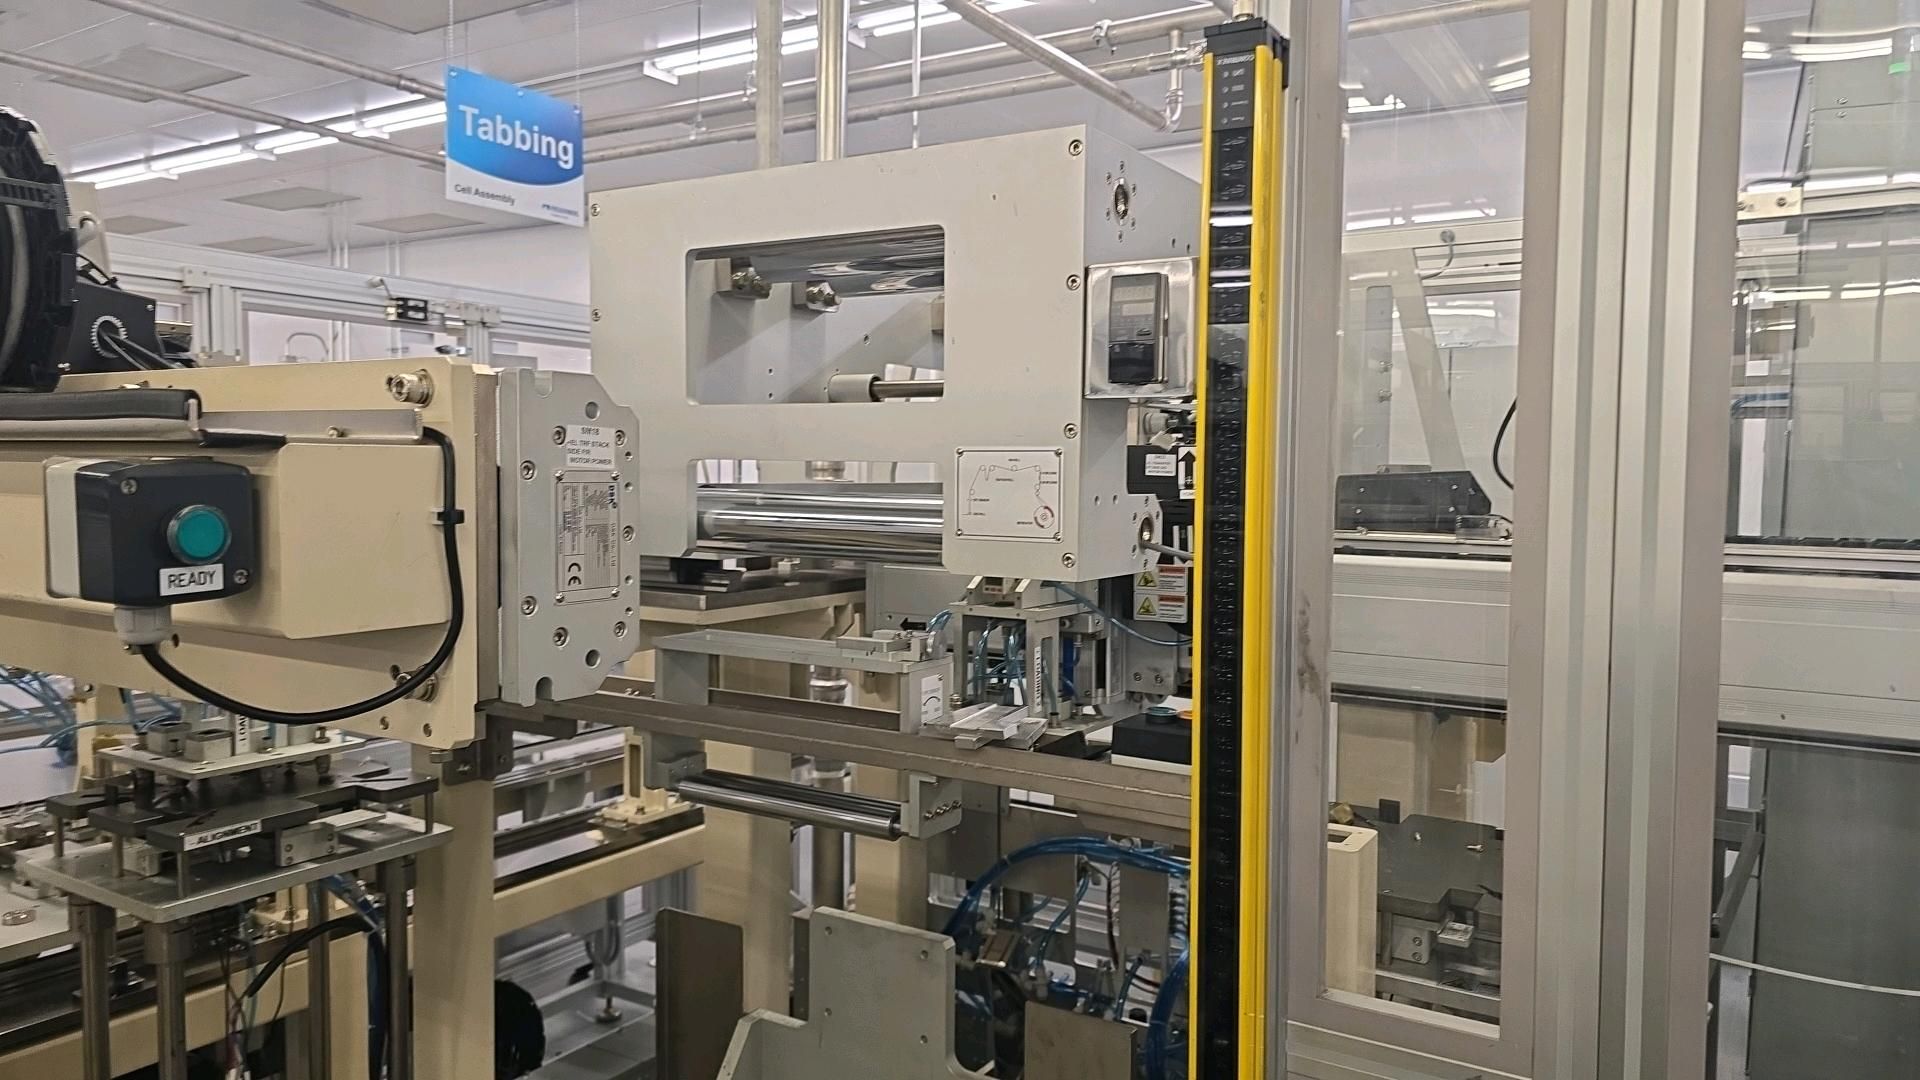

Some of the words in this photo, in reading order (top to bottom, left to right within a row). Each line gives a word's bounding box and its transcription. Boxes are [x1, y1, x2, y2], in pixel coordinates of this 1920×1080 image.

[459, 104, 574, 170] Tabbing
[454, 184, 472, 195] Cell
[474, 188, 515, 206] Assembly
[168, 570, 216, 589] READY
[197, 822, 258, 844] ALIGNMENT
